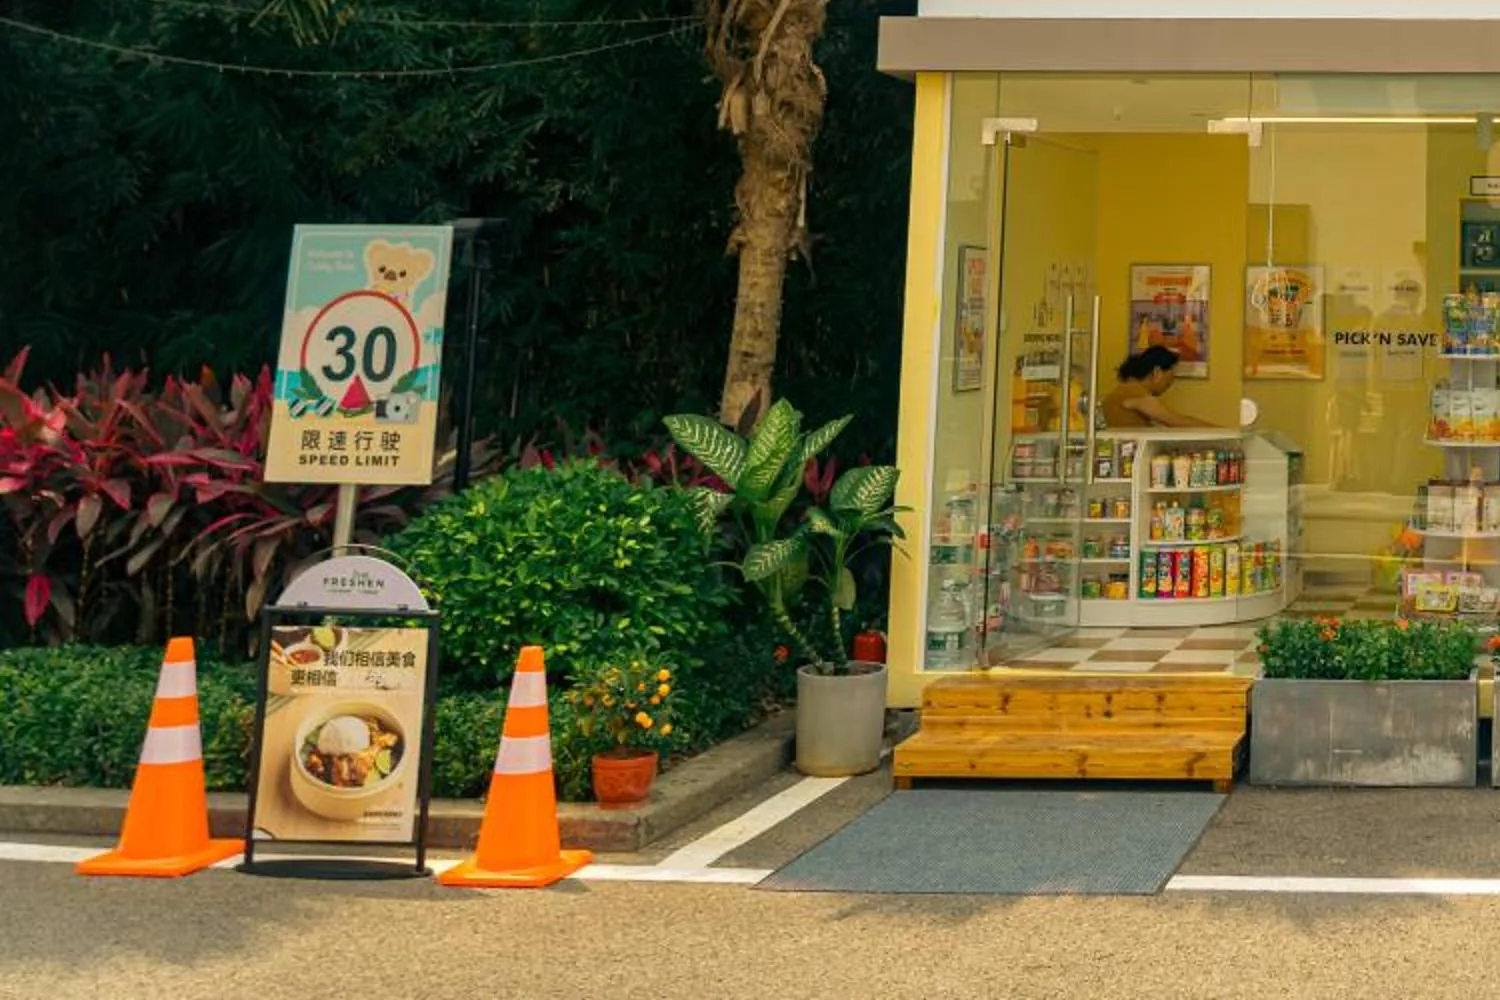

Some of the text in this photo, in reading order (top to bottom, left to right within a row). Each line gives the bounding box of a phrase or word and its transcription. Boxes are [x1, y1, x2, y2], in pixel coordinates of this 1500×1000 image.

[1334, 331, 1439, 346] PICK'N SAVE
[321, 326, 397, 382] 30
[301, 429, 401, 451] 限速行驶
[298, 454, 400, 467] SPEED LIMIT
[322, 576, 385, 589] FRESHEN
[323, 650, 416, 669] 我们相信美食
[290, 669, 337, 687] 更相信
